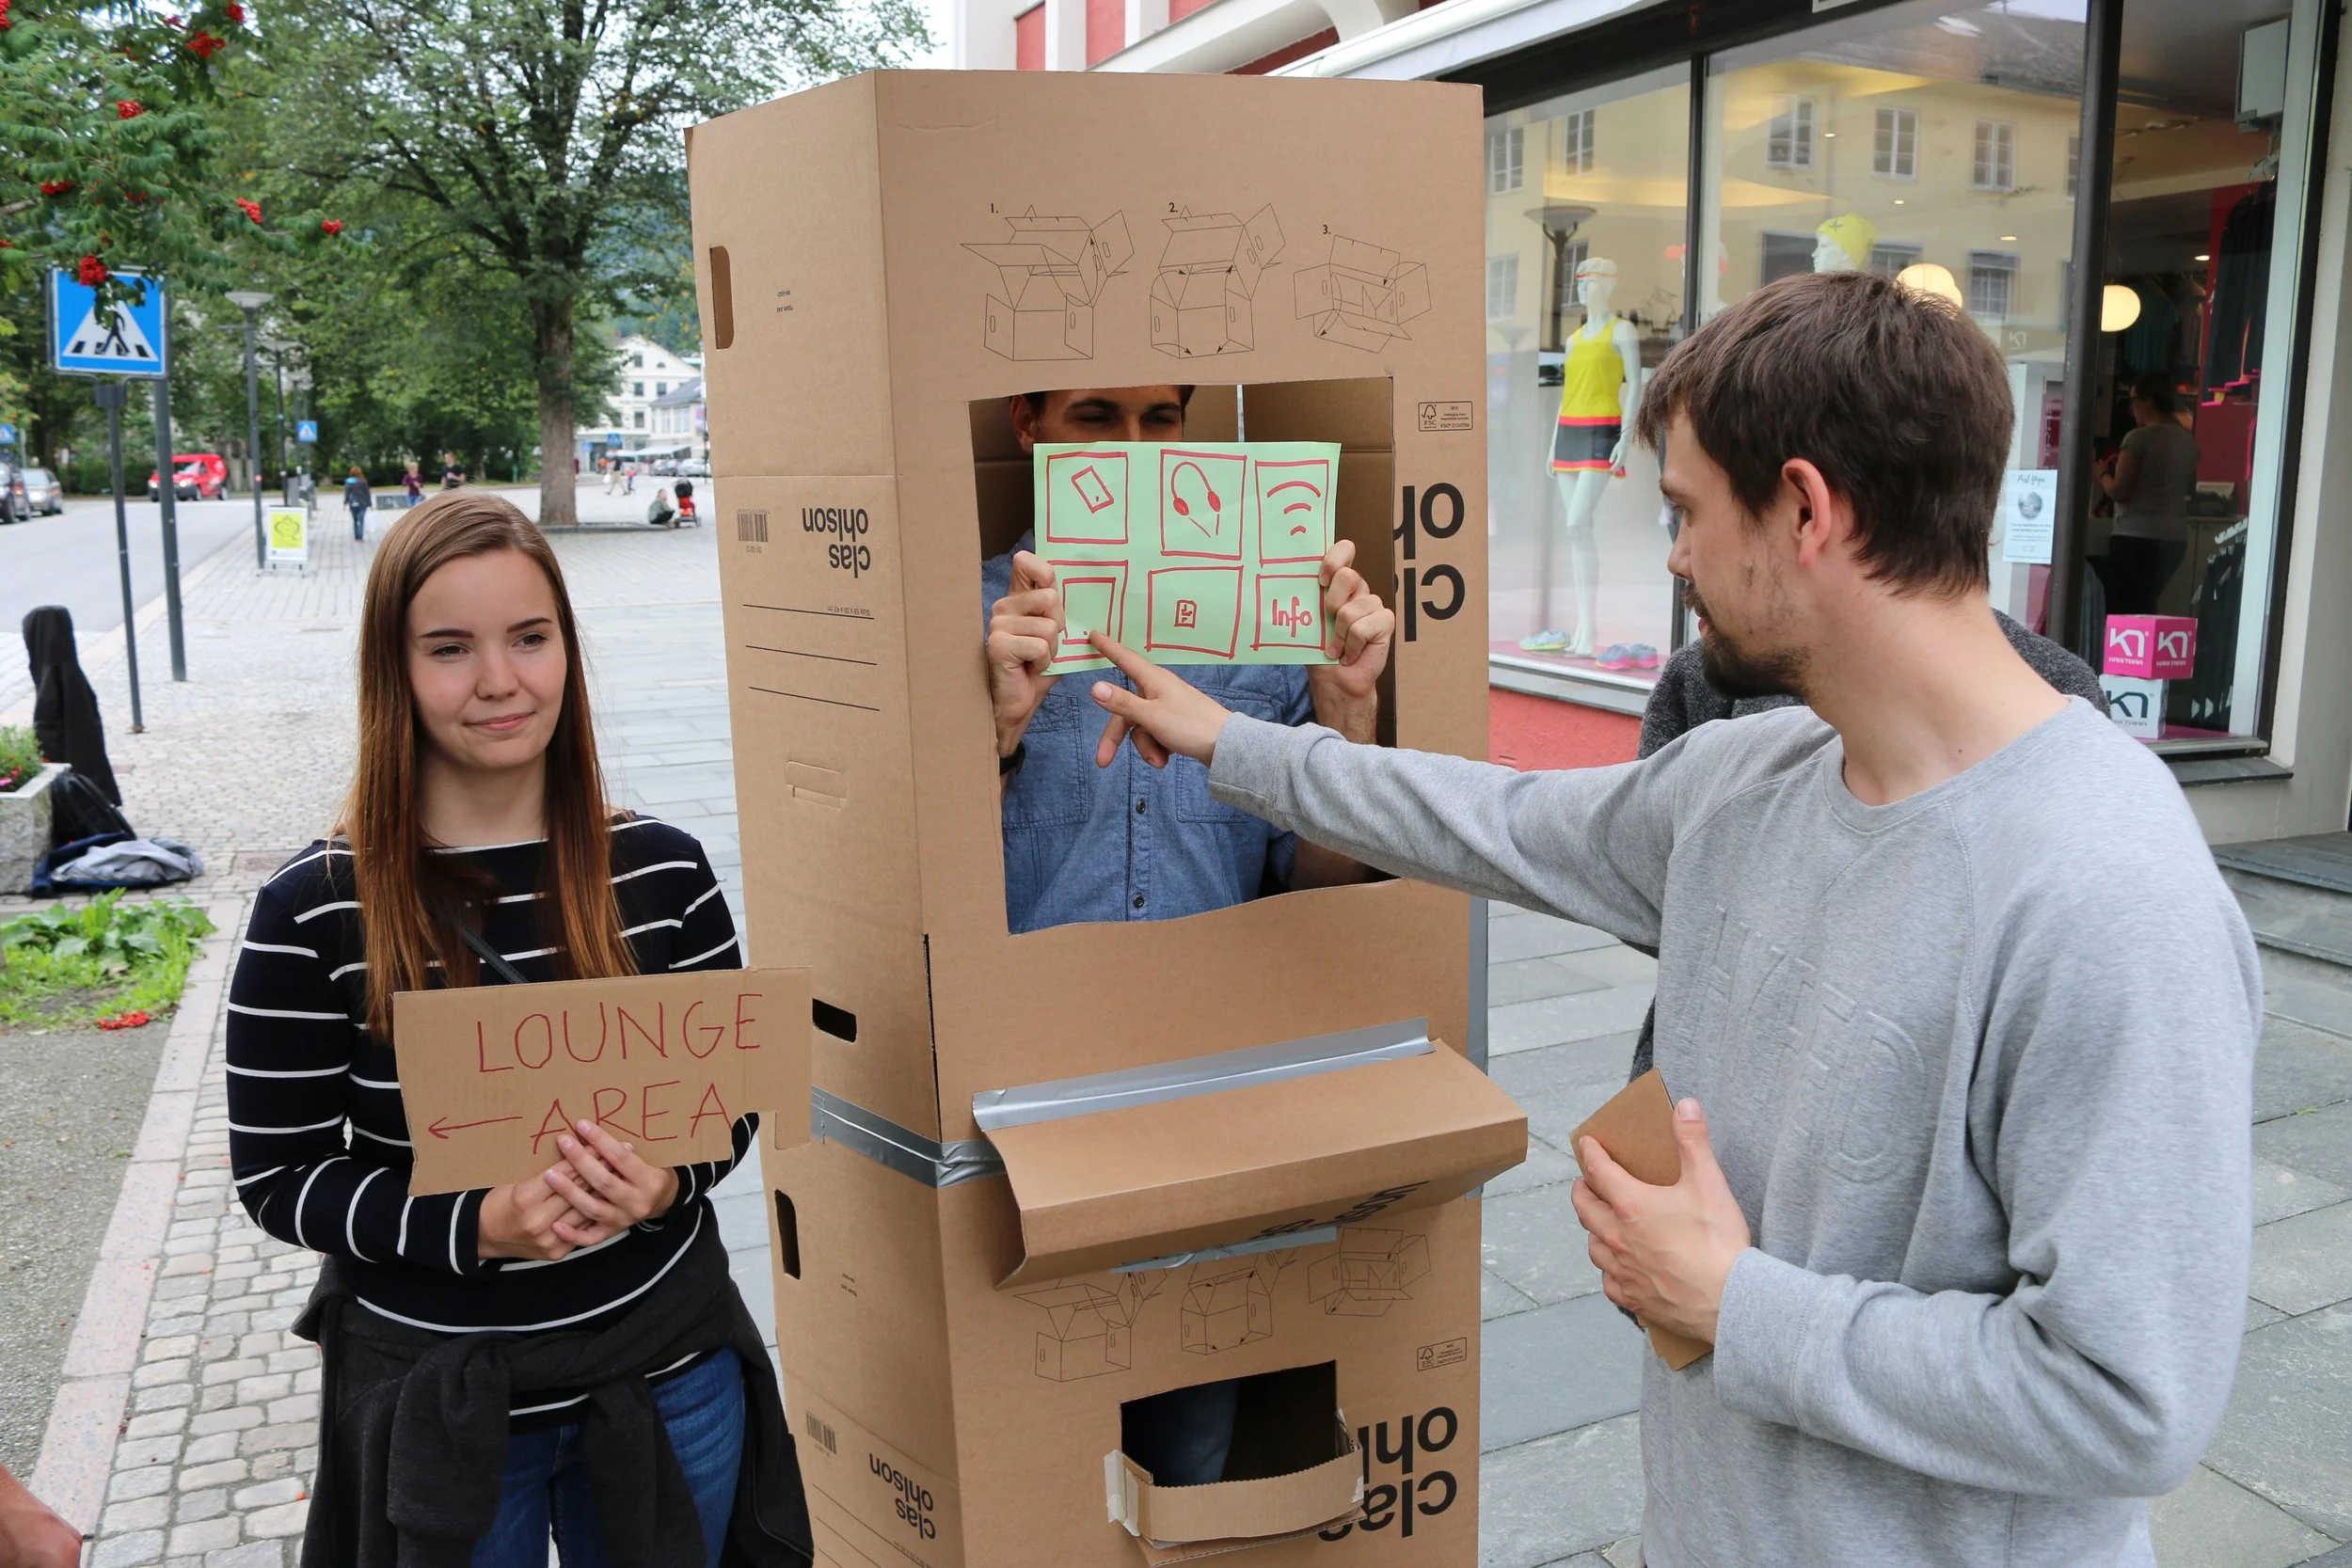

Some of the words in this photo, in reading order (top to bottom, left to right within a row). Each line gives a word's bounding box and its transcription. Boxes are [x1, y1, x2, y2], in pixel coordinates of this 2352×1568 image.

[802, 507, 869, 543] ohlson
[828, 544, 871, 578] clas
[1272, 595, 1313, 639] Info
[476, 993, 764, 1073] LOUNGE
[529, 1080, 734, 1155] AREA
[868, 1452, 934, 1513] ohlson
[894, 1497, 936, 1540] clas
